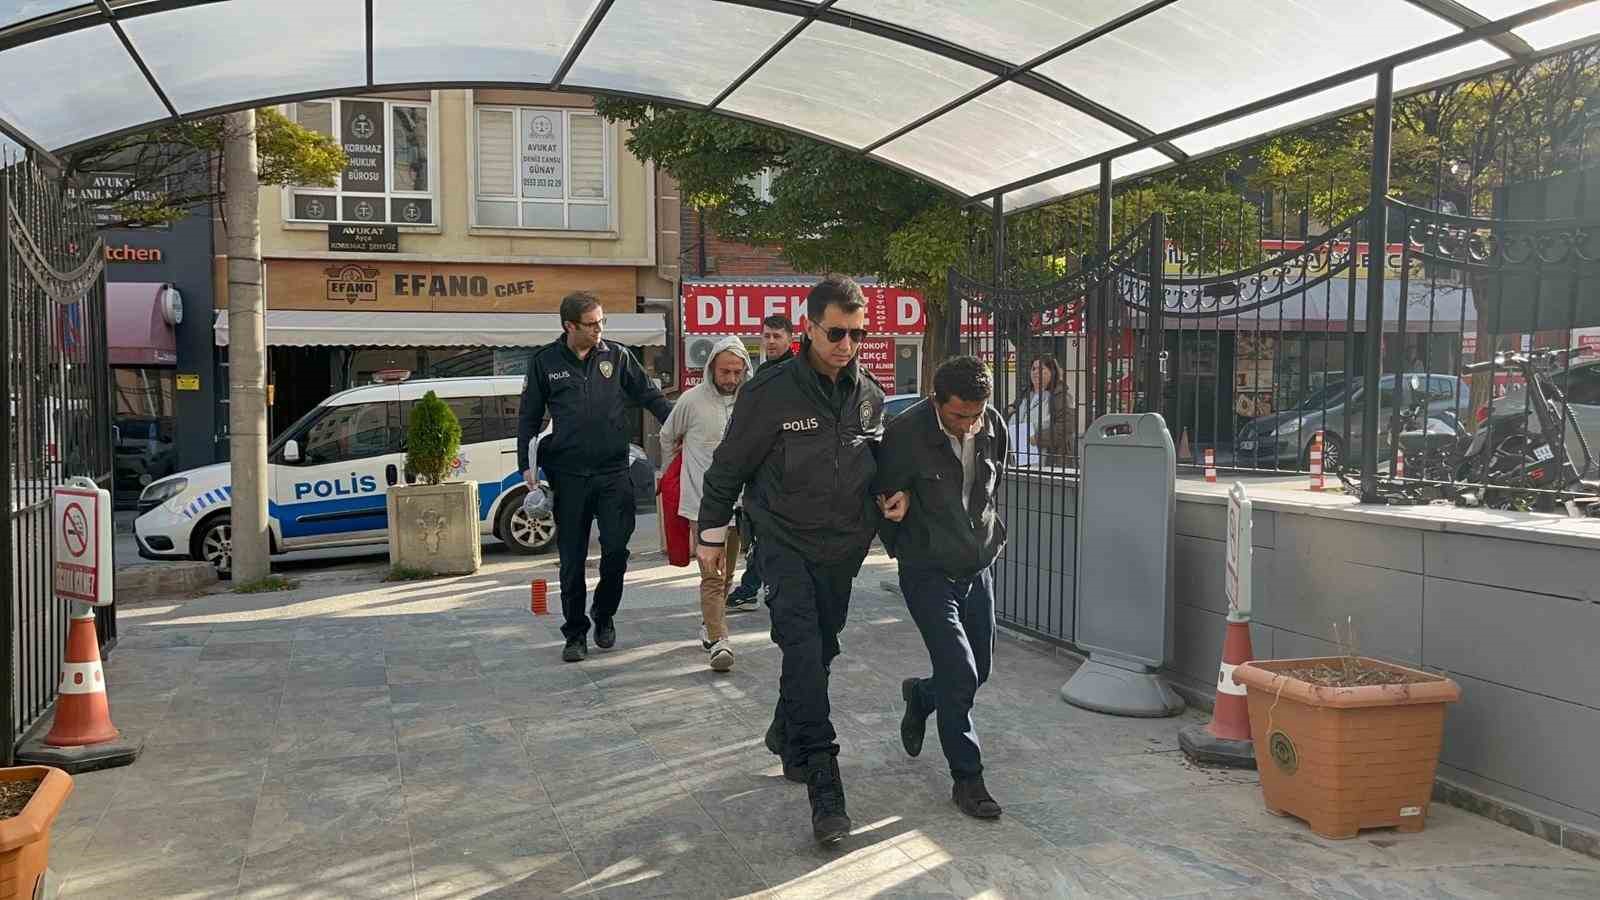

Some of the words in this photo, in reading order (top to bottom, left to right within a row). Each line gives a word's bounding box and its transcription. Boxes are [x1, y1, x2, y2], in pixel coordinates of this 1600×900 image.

[527, 143, 557, 152] AVUKAT
[348, 168, 380, 181] BÜROSU
[342, 226, 385, 236] AVUKAT
[331, 282, 373, 293] EFANO
[394, 272, 488, 298] EFANO
[494, 279, 536, 298] CAFE
[294, 471, 377, 499] POLİS
